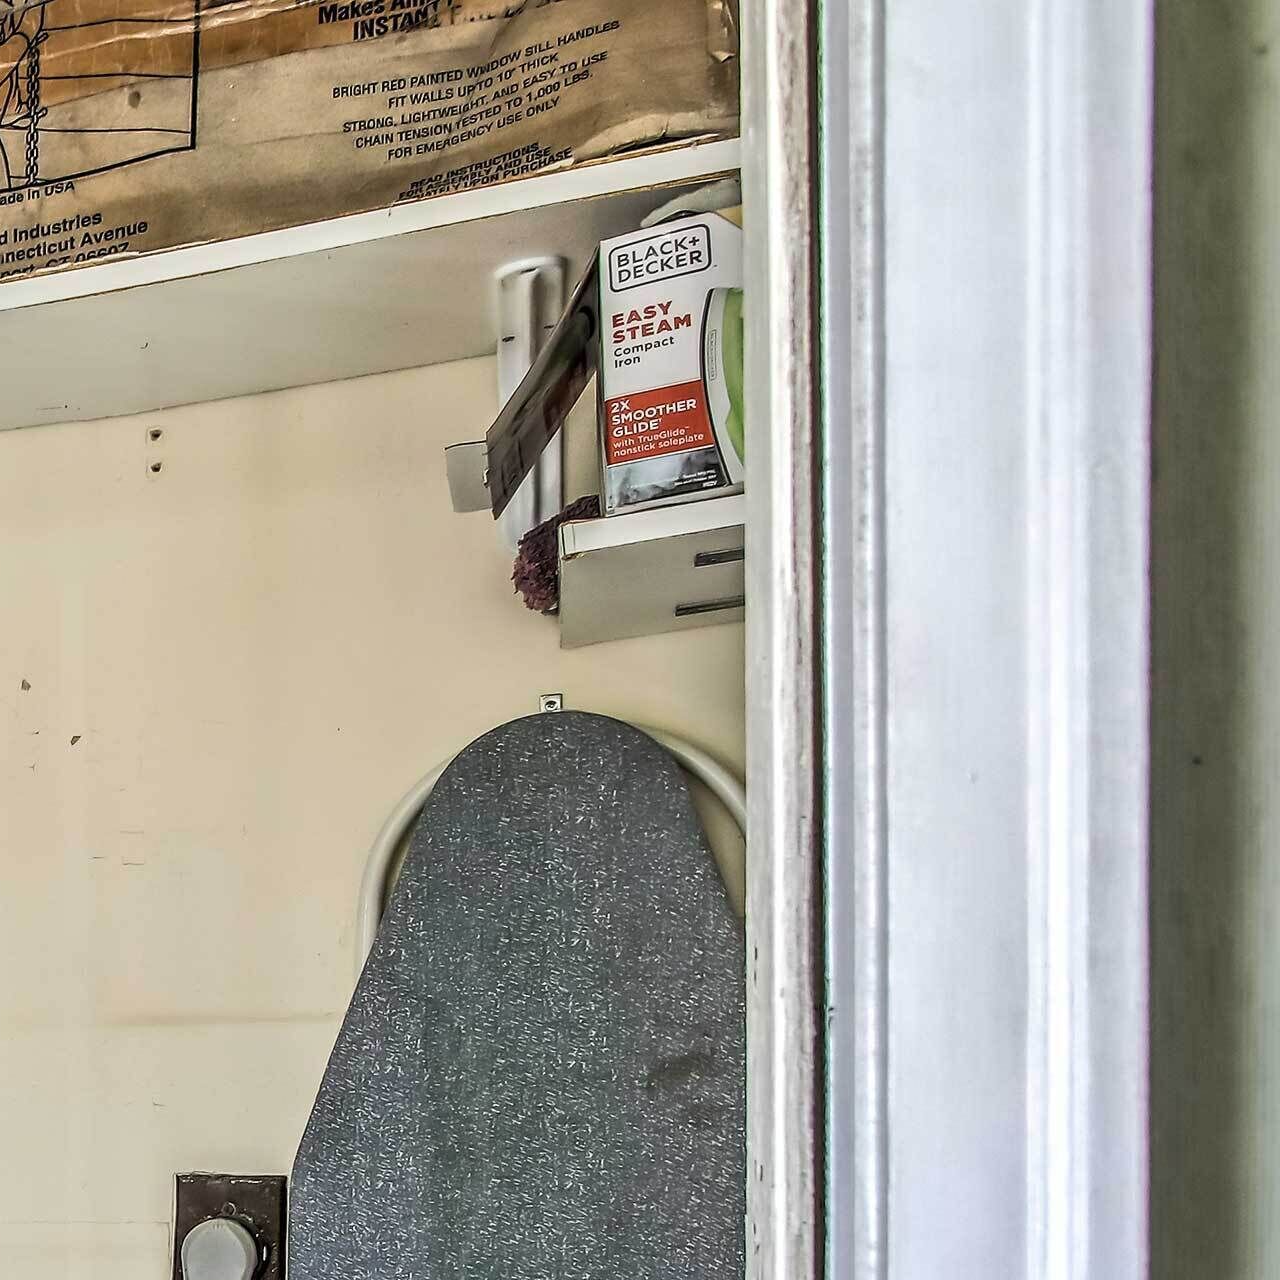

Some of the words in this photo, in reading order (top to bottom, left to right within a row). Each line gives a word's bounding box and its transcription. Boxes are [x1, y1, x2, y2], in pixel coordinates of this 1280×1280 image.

[333, 82, 379, 98] BRIGHT
[381, 79, 406, 92] RED
[410, 69, 463, 88] PAINTED
[525, 41, 554, 56] SILL
[557, 20, 620, 47] HANDLES
[388, 96, 407, 109] FIT
[410, 88, 453, 105] WALLS
[457, 84, 476, 97] UP
[478, 78, 493, 91] TO
[519, 52, 559, 73] THICK
[492, 83, 519, 100] AND
[523, 69, 557, 89] EASY
[560, 61, 577, 74] TO
[582, 50, 608, 67] USE
[355, 133, 393, 149] CHAIN
[396, 123, 452, 141] TENSION
[456, 104, 501, 130] TESTED
[505, 98, 522, 110] TO
[388, 147, 412, 160] FOR
[416, 122, 493, 155] EMERGENCY
[497, 111, 522, 128] USE
[526, 96, 560, 117] ONLY
[503, 147, 573, 178] PURCHASE
[529, 147, 551, 161] USE
[45, 181, 75, 197] USA
[14, 212, 102, 243] Industries
[80, 221, 148, 248] Avenue
[618, 250, 703, 283] DECKER
[612, 300, 673, 328] EASY
[612, 313, 692, 344] STEAM
[614, 336, 675, 357] Compact
[614, 355, 641, 368] Iron
[611, 400, 631, 413] 2X
[611, 398, 697, 426] SMOOTHER
[613, 437, 635, 449] with
[613, 441, 656, 457] nonstick
[658, 433, 704, 449] soleplate
